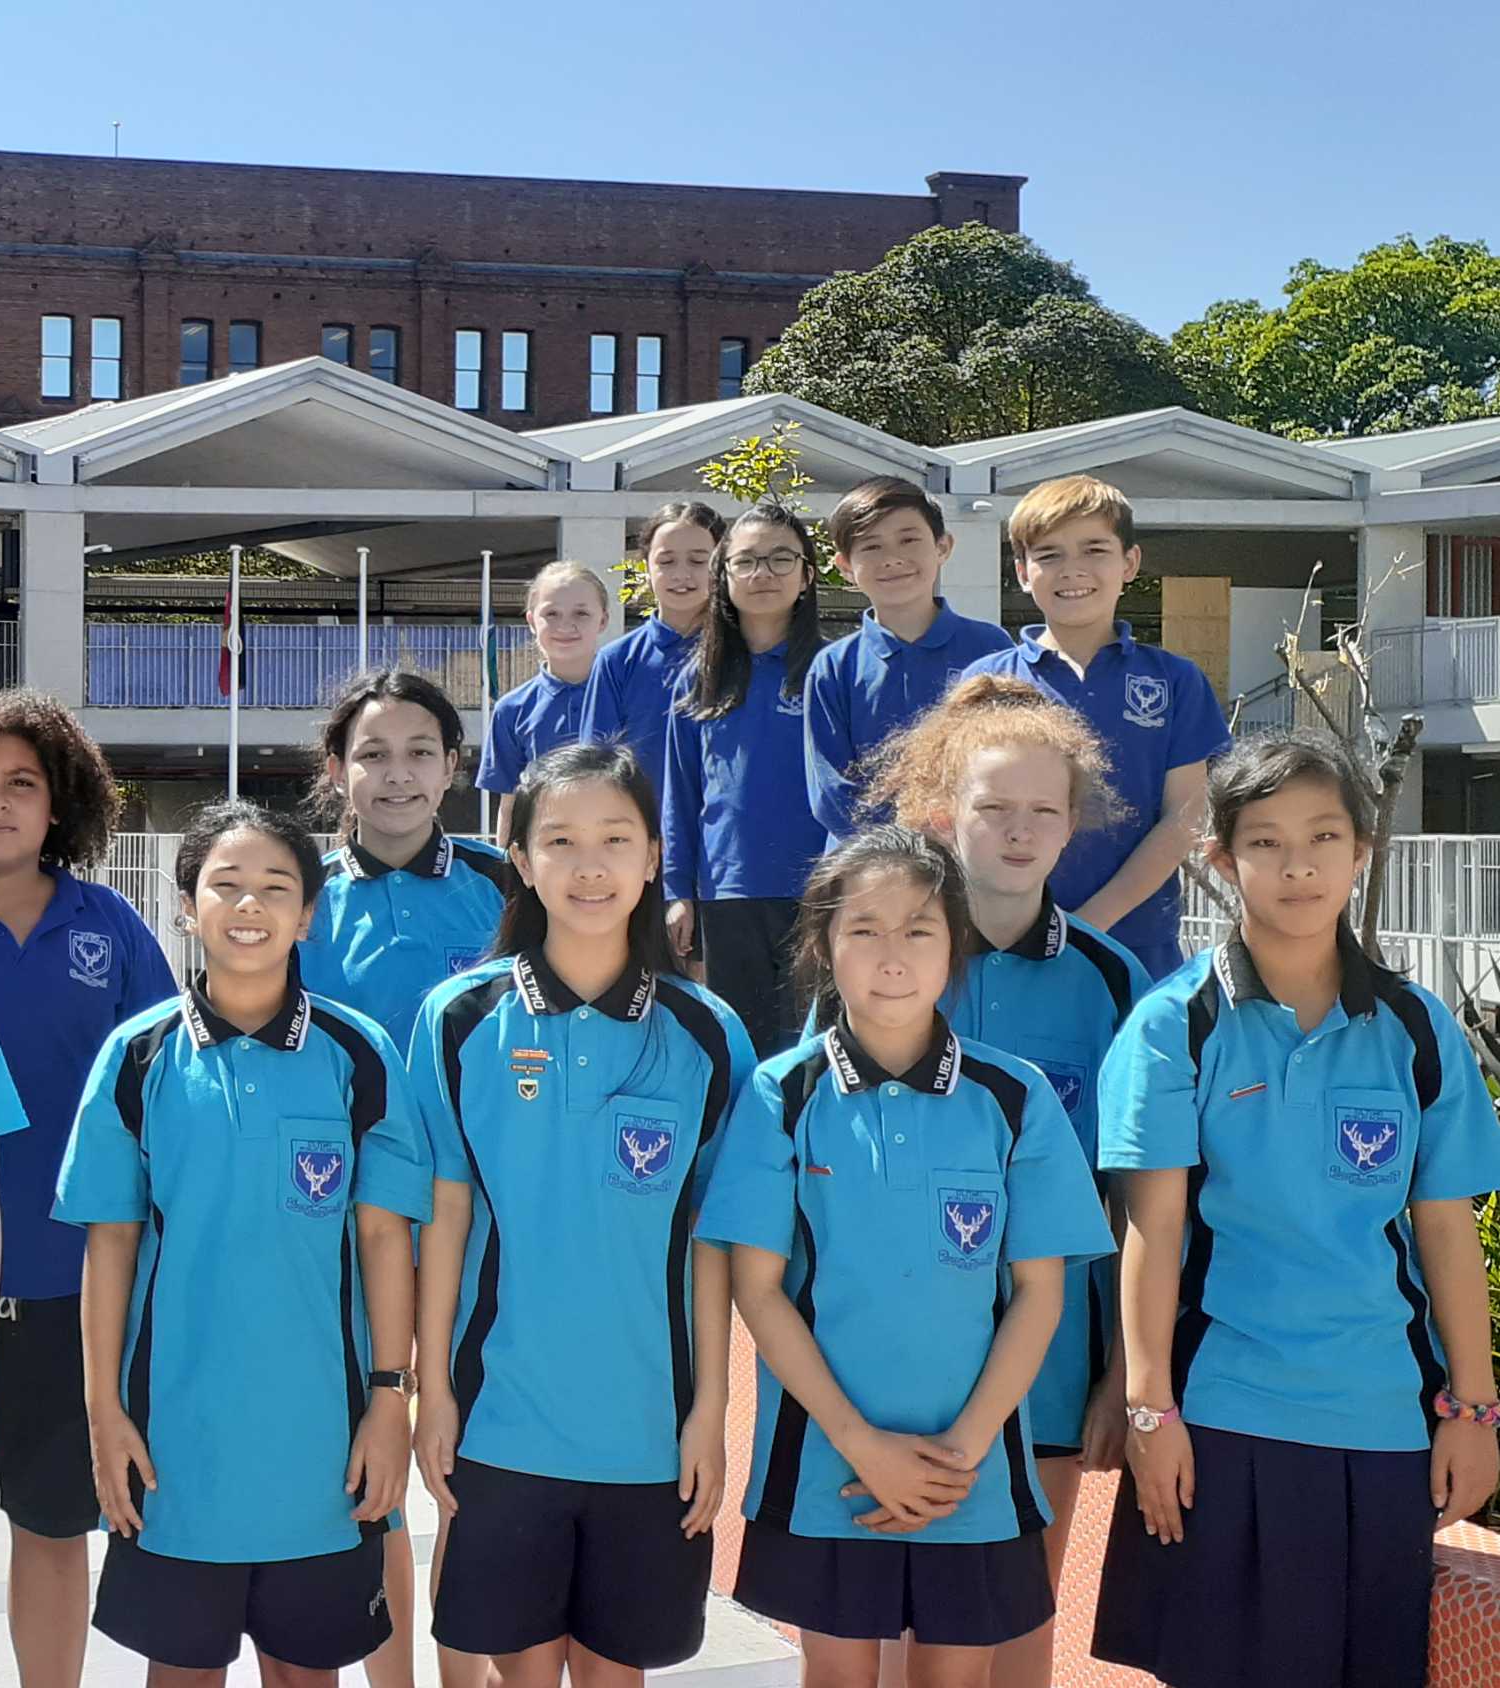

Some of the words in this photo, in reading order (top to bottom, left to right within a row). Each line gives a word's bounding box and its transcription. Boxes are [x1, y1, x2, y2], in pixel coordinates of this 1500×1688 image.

[1045, 912, 1059, 957] PUBLIC
[520, 960, 546, 1010] ULTIMO
[628, 967, 651, 1017] PUBLIC
[187, 998, 211, 1042] ULTIMO
[285, 998, 306, 1047] PUBLIC
[830, 1033, 860, 1085] ULTIMO
[933, 1039, 955, 1089] PUBLIC
